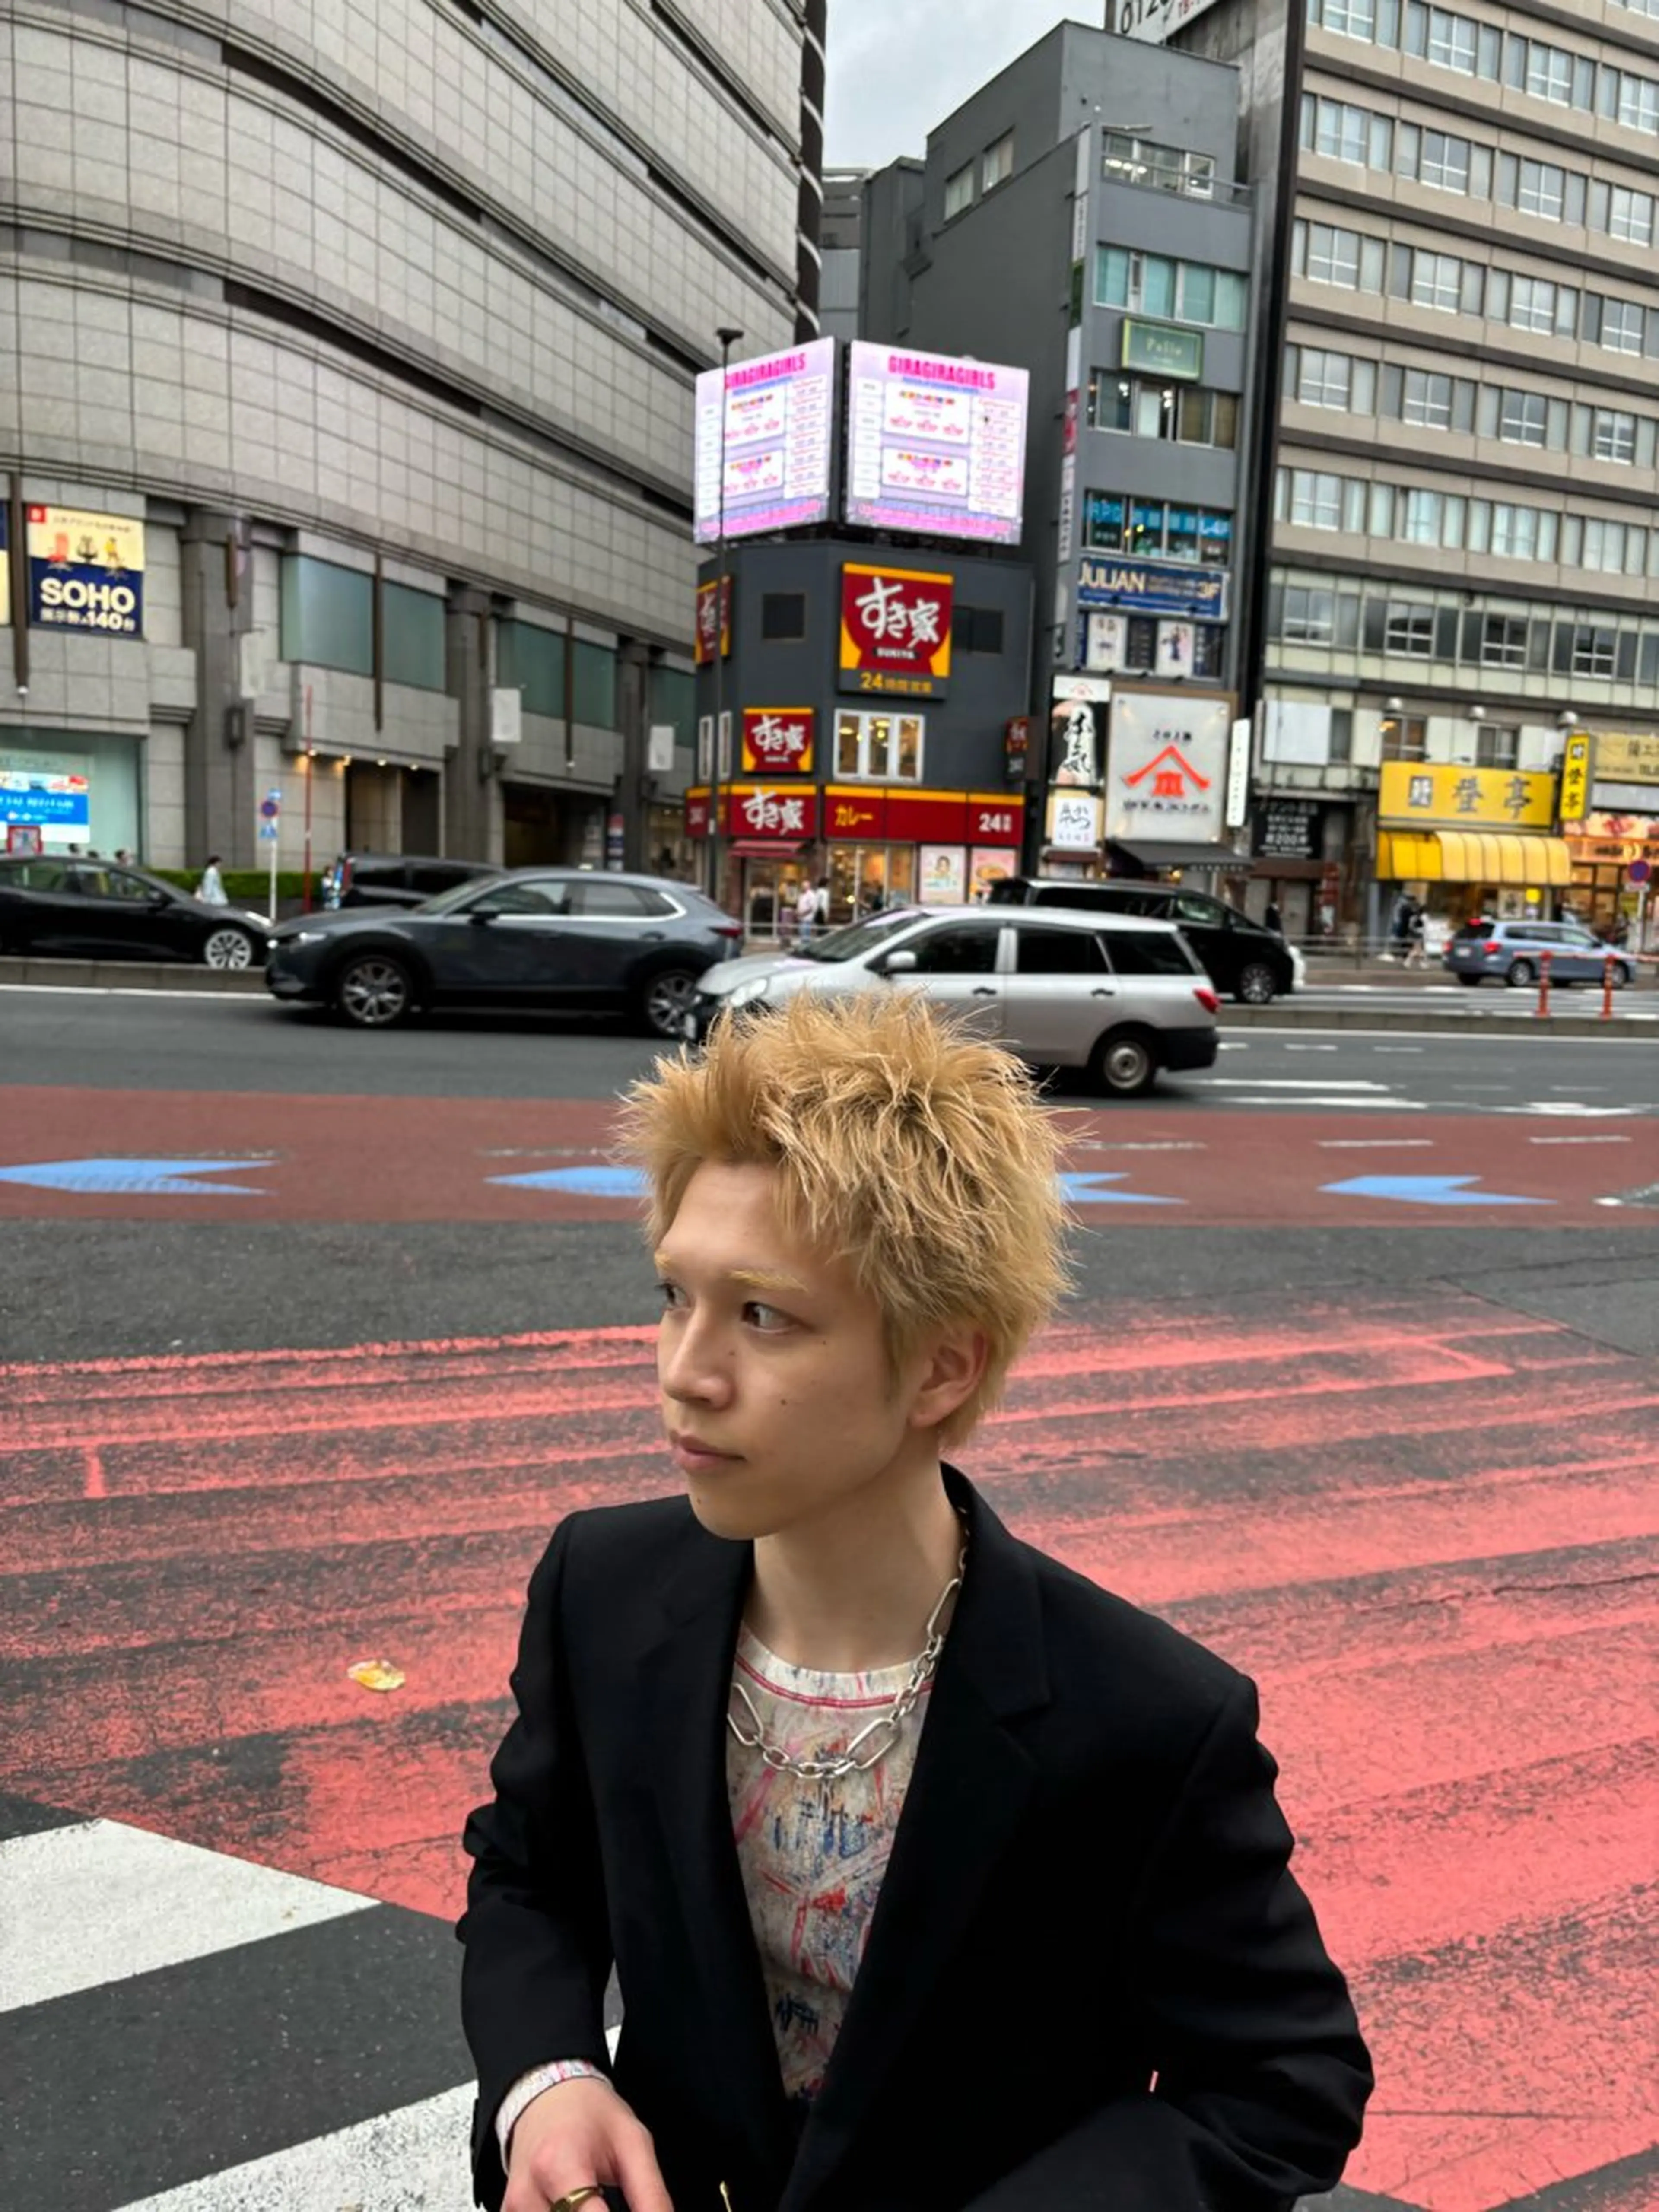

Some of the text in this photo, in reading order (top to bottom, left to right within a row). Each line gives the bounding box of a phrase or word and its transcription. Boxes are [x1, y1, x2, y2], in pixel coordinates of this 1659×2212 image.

[888, 356, 995, 390] GIRAGIRAGIRLS
[40, 577, 135, 614] SOHO
[1078, 562, 1146, 594] JULIAN
[1197, 580, 1220, 600] 3F
[855, 576, 939, 649] すき家
[751, 713, 805, 756] すき家
[741, 785, 804, 836] すき家
[835, 804, 873, 826] カレー
